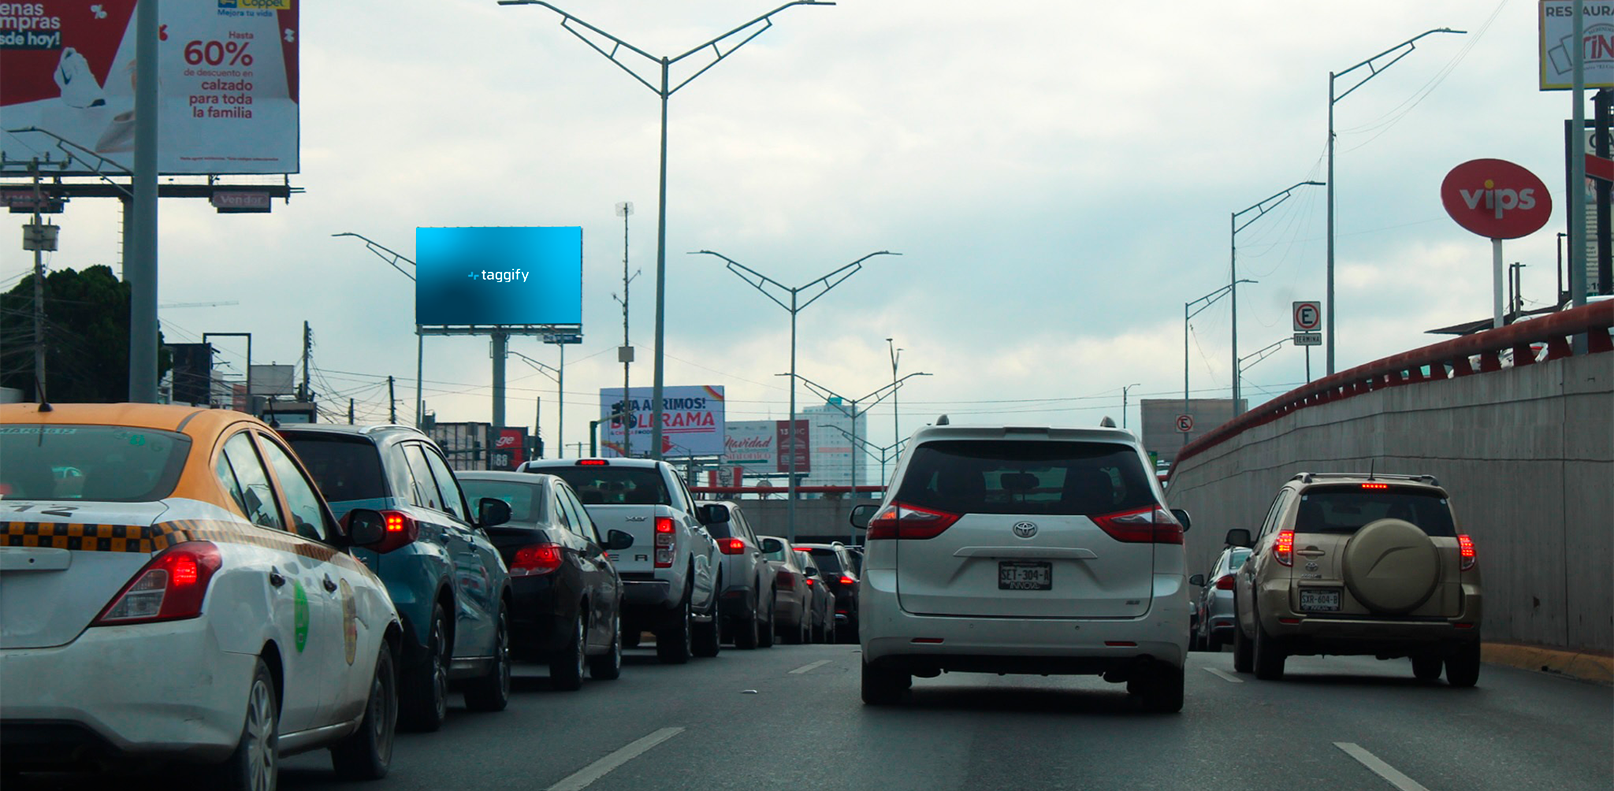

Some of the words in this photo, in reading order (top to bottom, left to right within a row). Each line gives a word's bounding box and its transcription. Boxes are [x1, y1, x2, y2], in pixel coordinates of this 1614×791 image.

[0, 3, 44, 16] enas
[218, 9, 244, 17] Mejora
[257, 9, 273, 17] vida
[1546, 6, 1614, 17] RESAUR
[0, 16, 61, 32] mpras
[0, 31, 25, 45] sde
[27, 31, 60, 48] hoy!
[229, 31, 254, 39] Hasta
[184, 40, 254, 67] 60%
[184, 68, 195, 76] de
[197, 68, 241, 77] descuento
[201, 79, 253, 91] calzado
[189, 95, 219, 106] para
[222, 93, 253, 105] toda
[193, 106, 204, 118] la
[207, 106, 252, 118] familia
[1459, 179, 1536, 219] vips
[482, 268, 529, 283] taggify
[1302, 308, 1313, 325] E
[642, 398, 706, 411] ARIMOS!
[724, 435, 773, 453] Navidad
